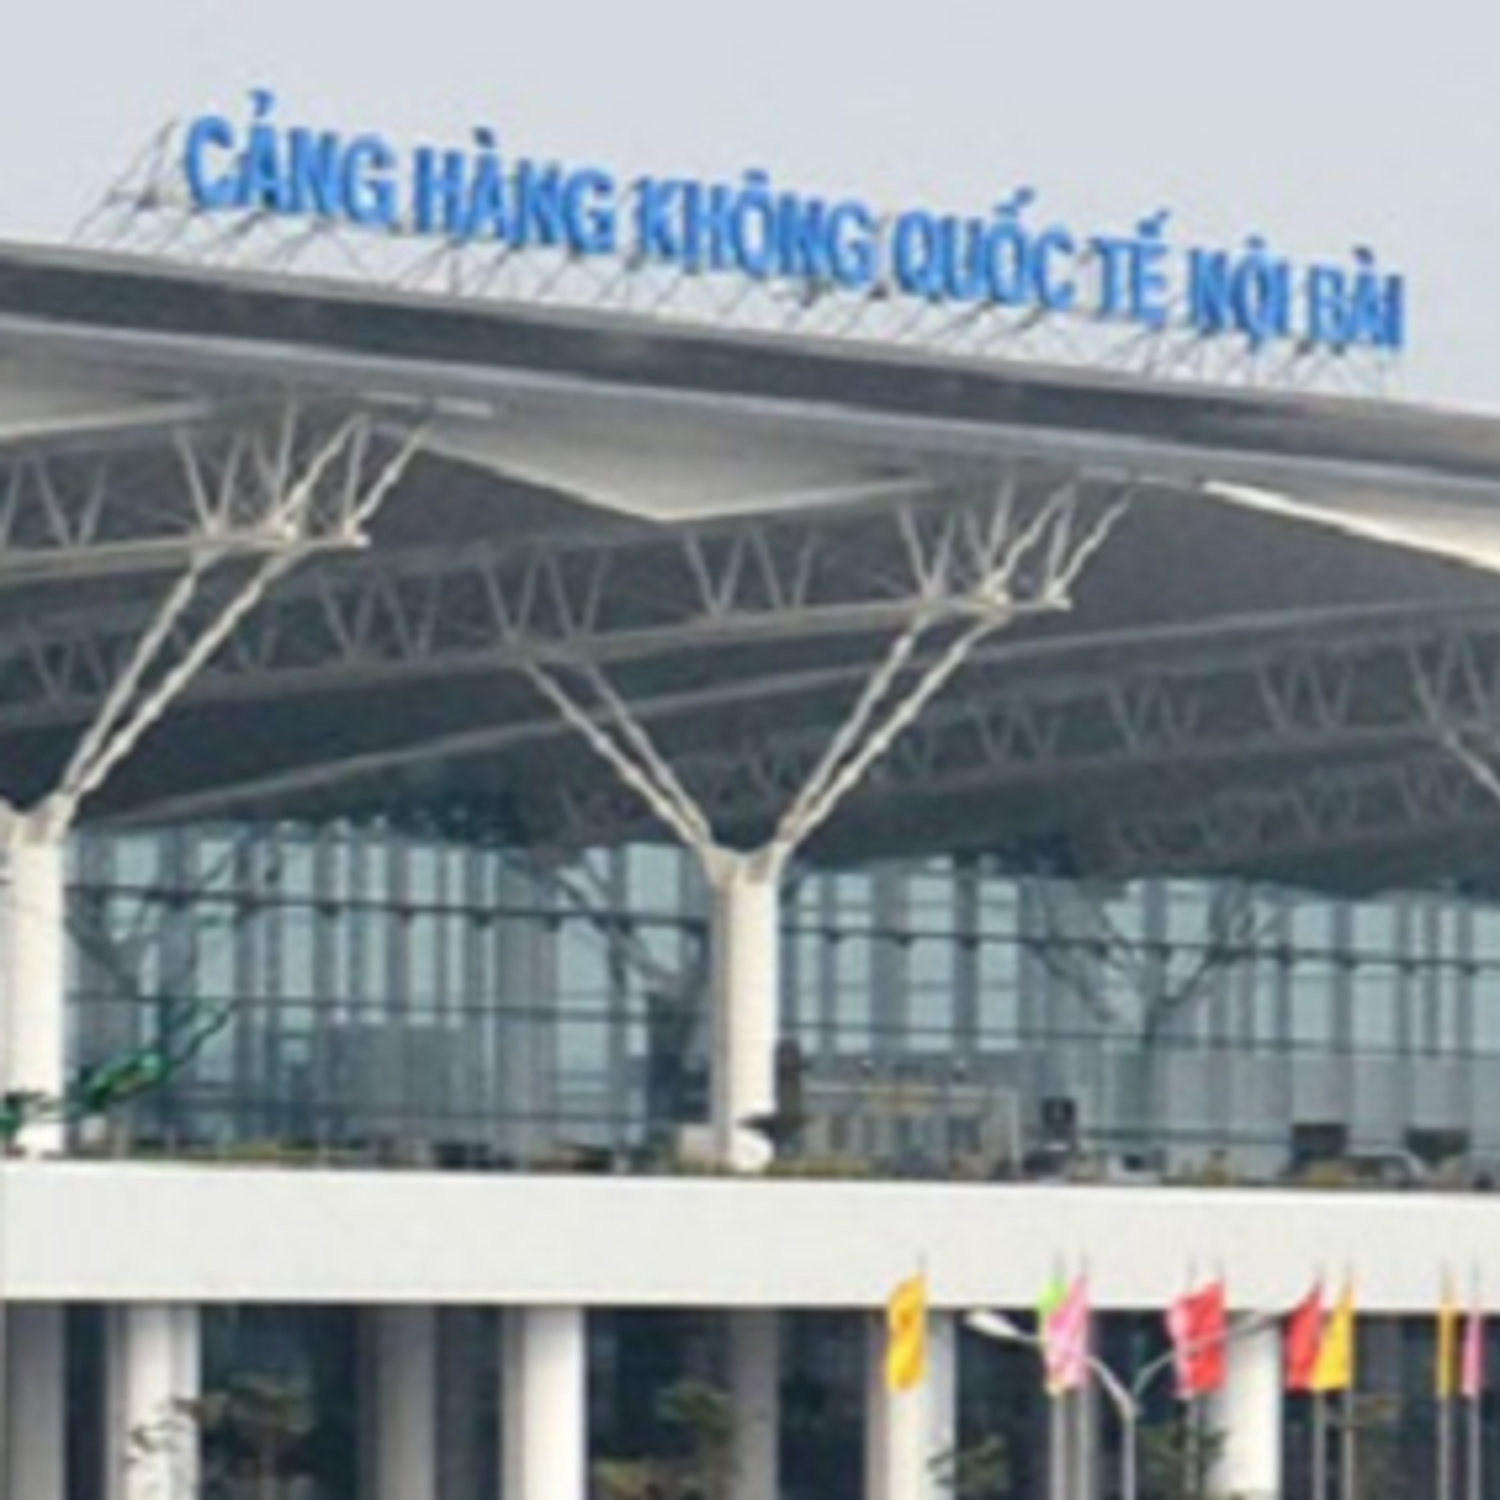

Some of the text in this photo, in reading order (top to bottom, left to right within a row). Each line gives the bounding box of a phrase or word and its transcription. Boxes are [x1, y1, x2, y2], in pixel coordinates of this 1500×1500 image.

[184, 88, 396, 227] CẢNG
[411, 127, 617, 254] HÀNG
[633, 168, 873, 288] KHÔNG
[891, 187, 1076, 310] QUỐC
[1092, 210, 1168, 328] TẾ
[1306, 245, 1407, 350] BÀI
